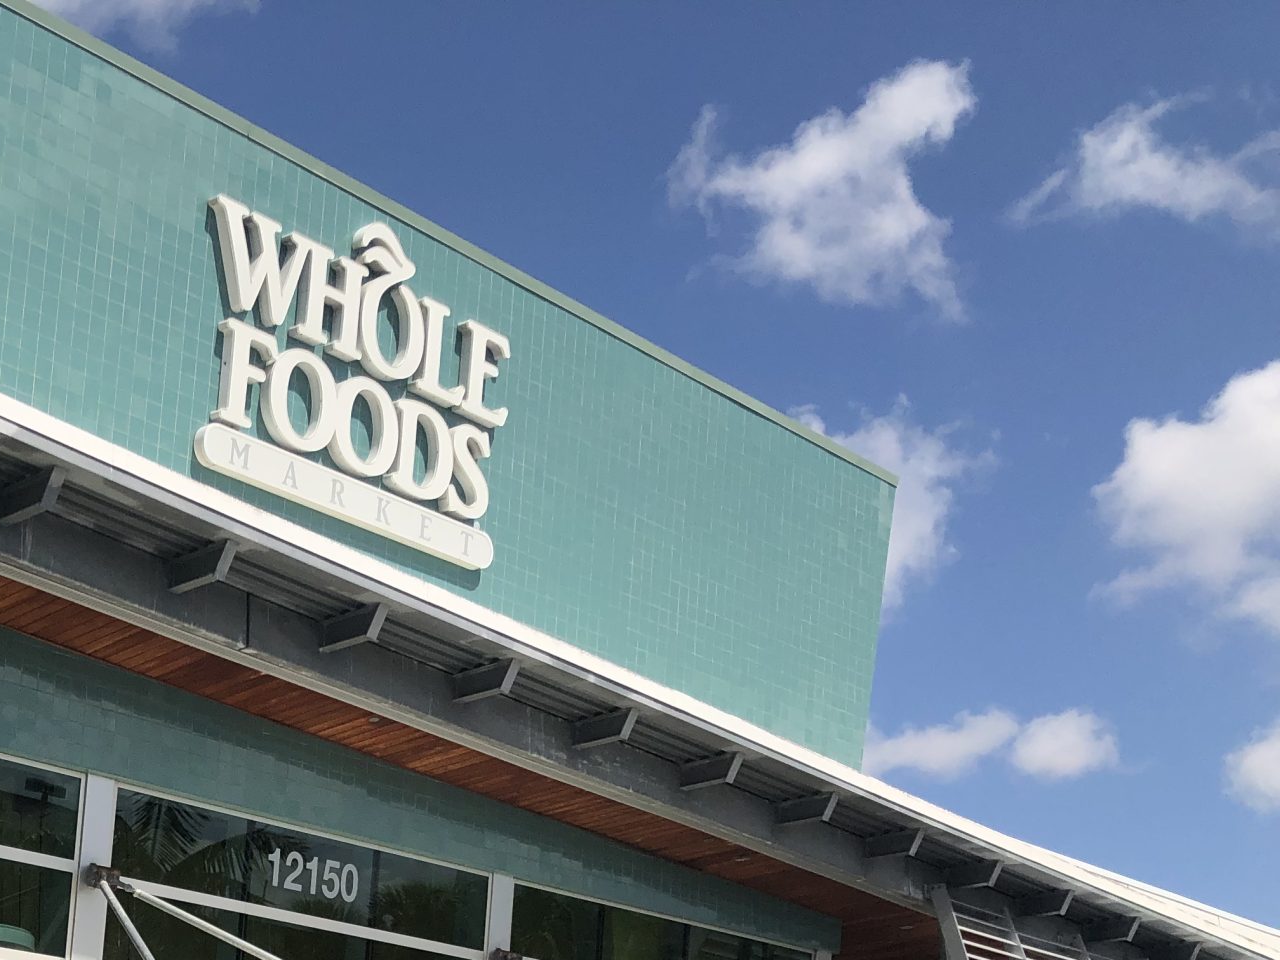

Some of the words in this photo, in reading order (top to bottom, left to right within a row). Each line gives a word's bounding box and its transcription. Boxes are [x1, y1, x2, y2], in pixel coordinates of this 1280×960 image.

[208, 194, 511, 428] WHOLE
[210, 317, 492, 520] FOODS
[228, 436, 480, 558] MARKET
[268, 847, 359, 903] 12150
